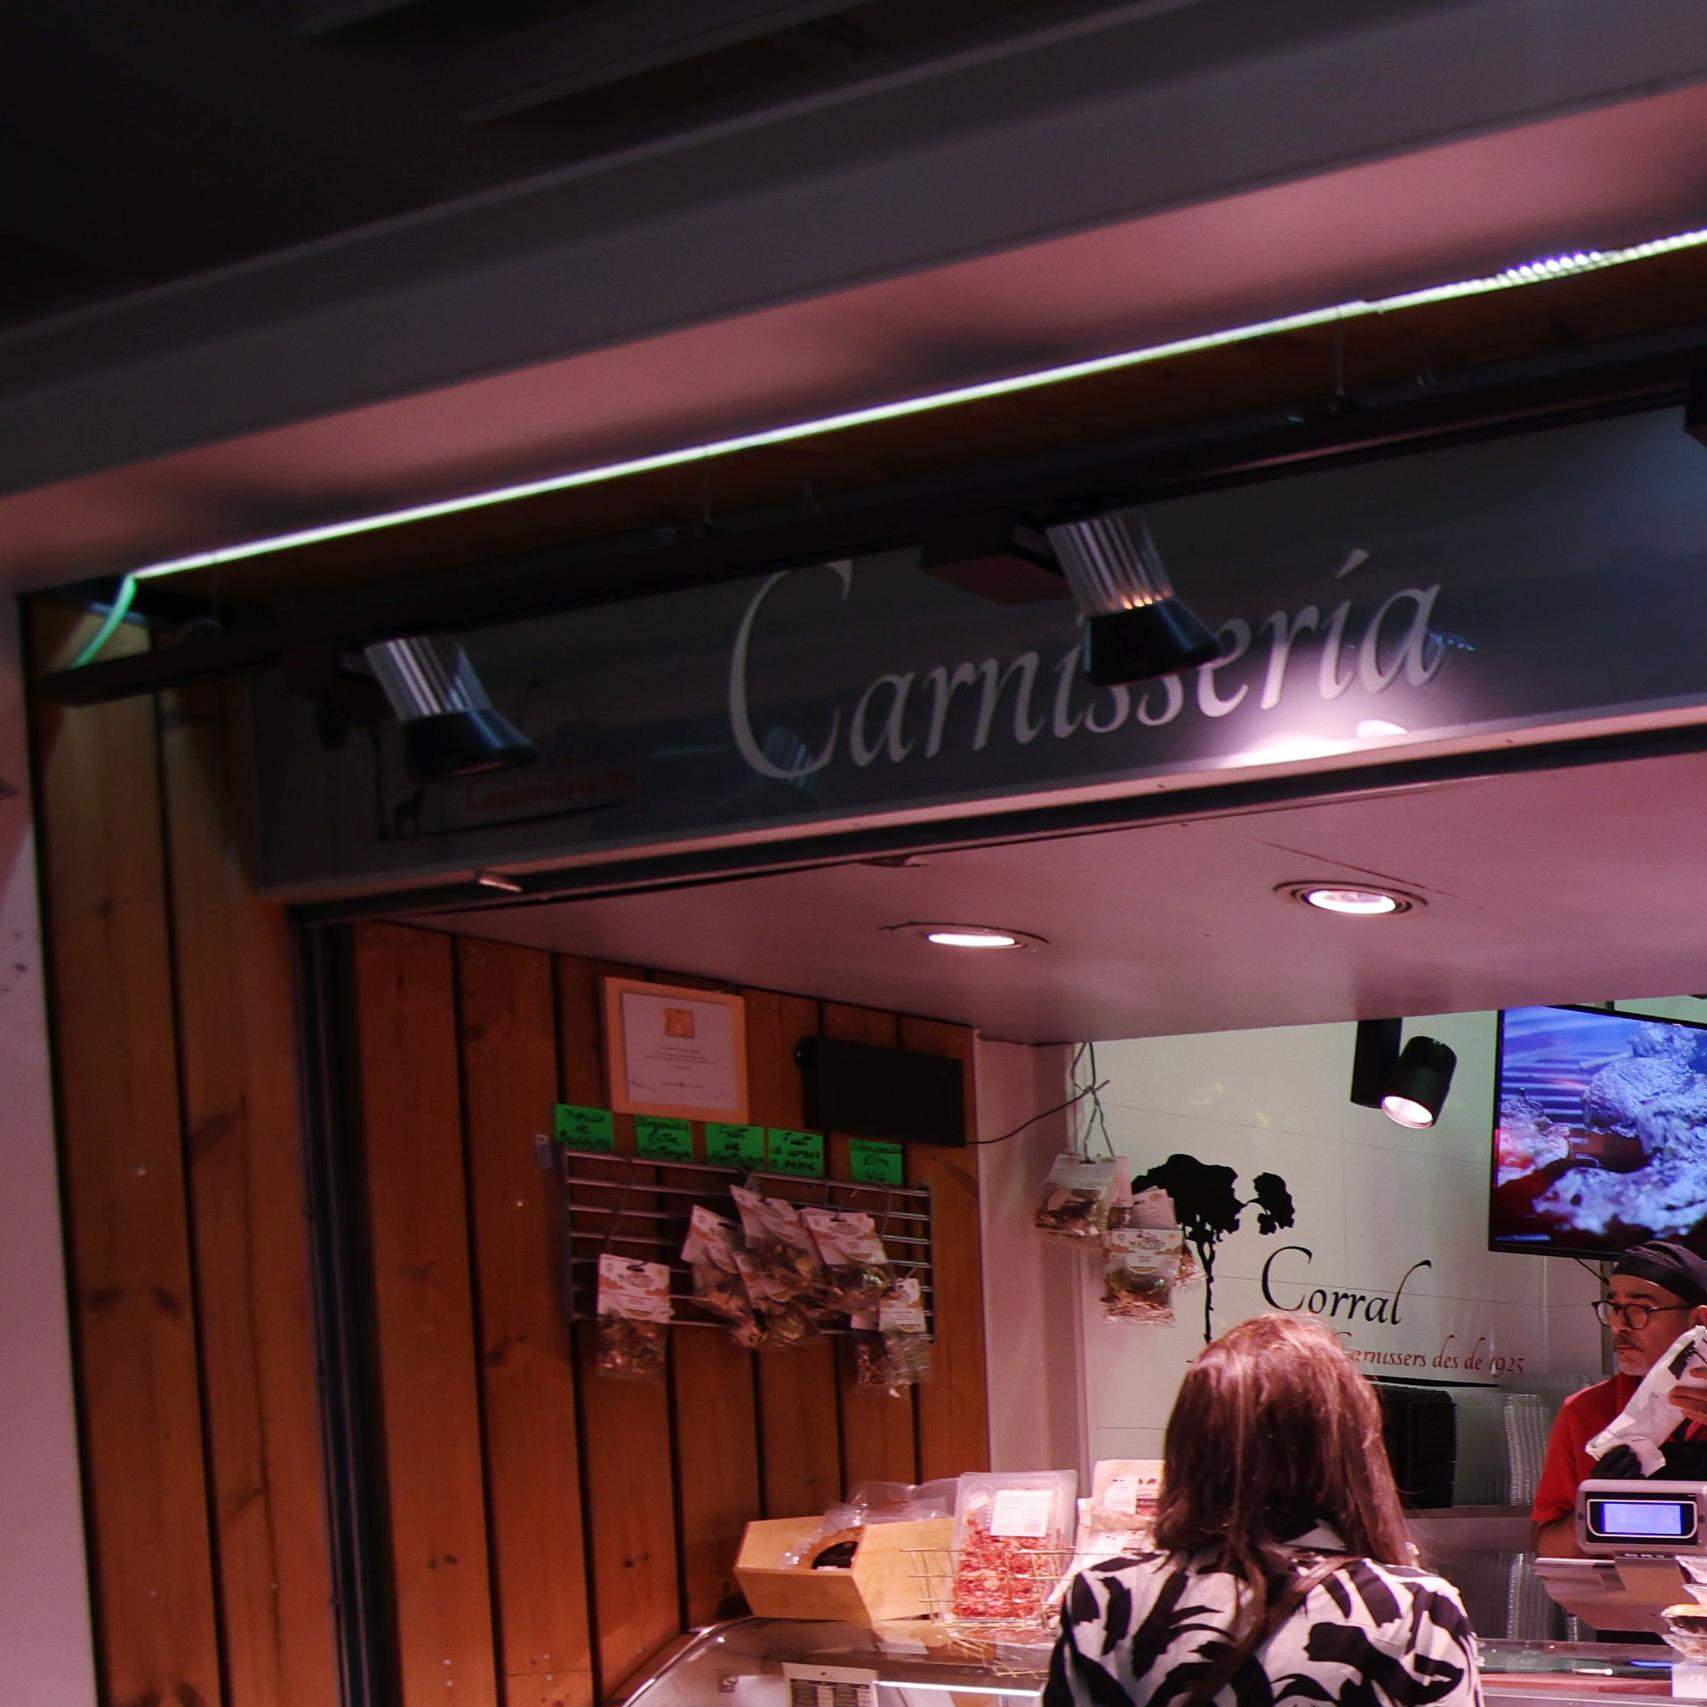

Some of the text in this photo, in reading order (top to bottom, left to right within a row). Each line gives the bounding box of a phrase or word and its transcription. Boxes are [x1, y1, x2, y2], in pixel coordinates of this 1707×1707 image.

[1262, 1245, 1432, 1325] Corral
[1335, 1332, 1525, 1378] arnissers des de 1925
